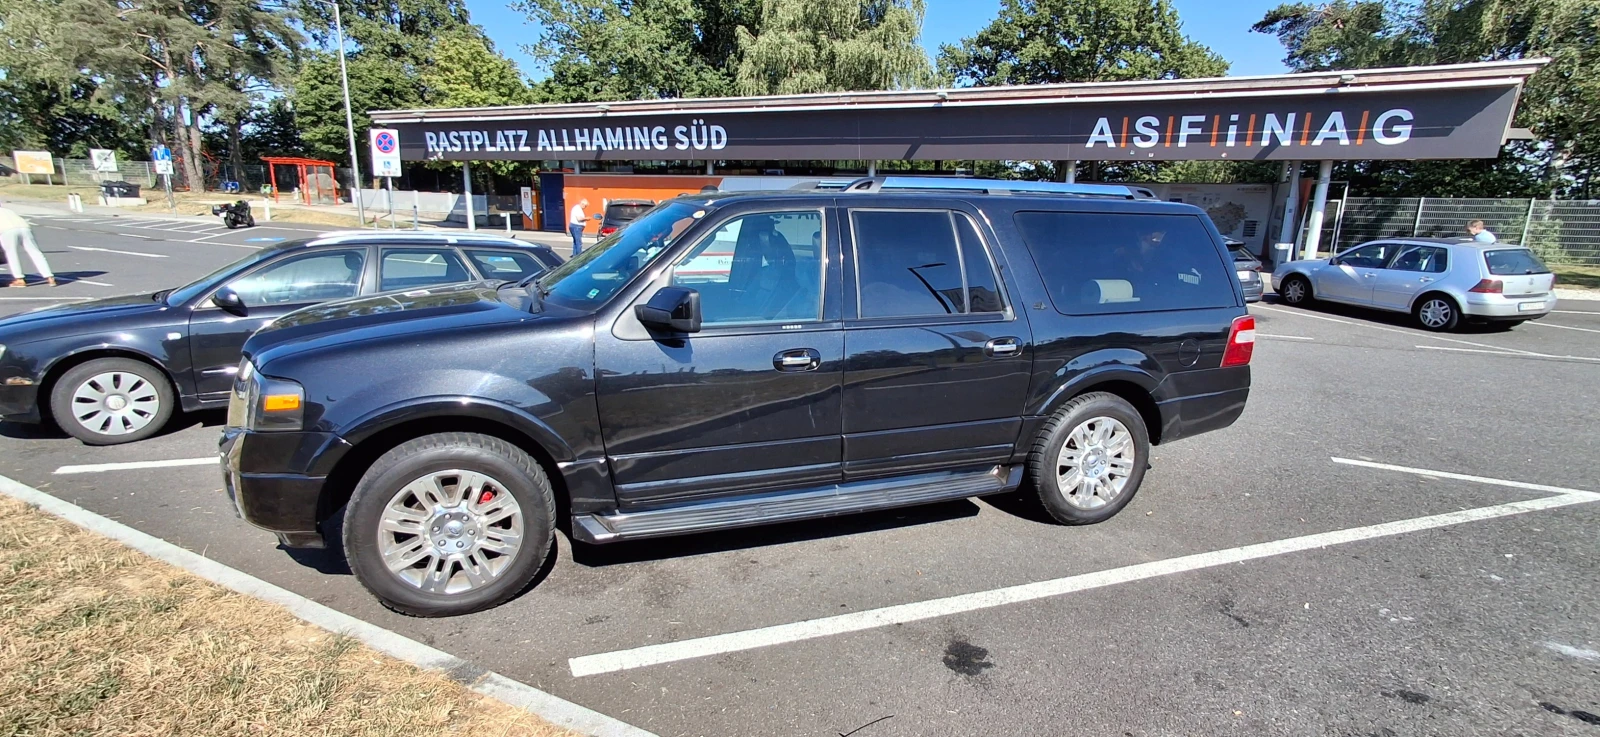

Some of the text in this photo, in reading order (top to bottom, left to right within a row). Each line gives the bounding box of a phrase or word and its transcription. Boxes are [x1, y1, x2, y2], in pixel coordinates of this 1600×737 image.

[425, 119, 728, 153] RASTPLATZ ALLHAMING SÜD
